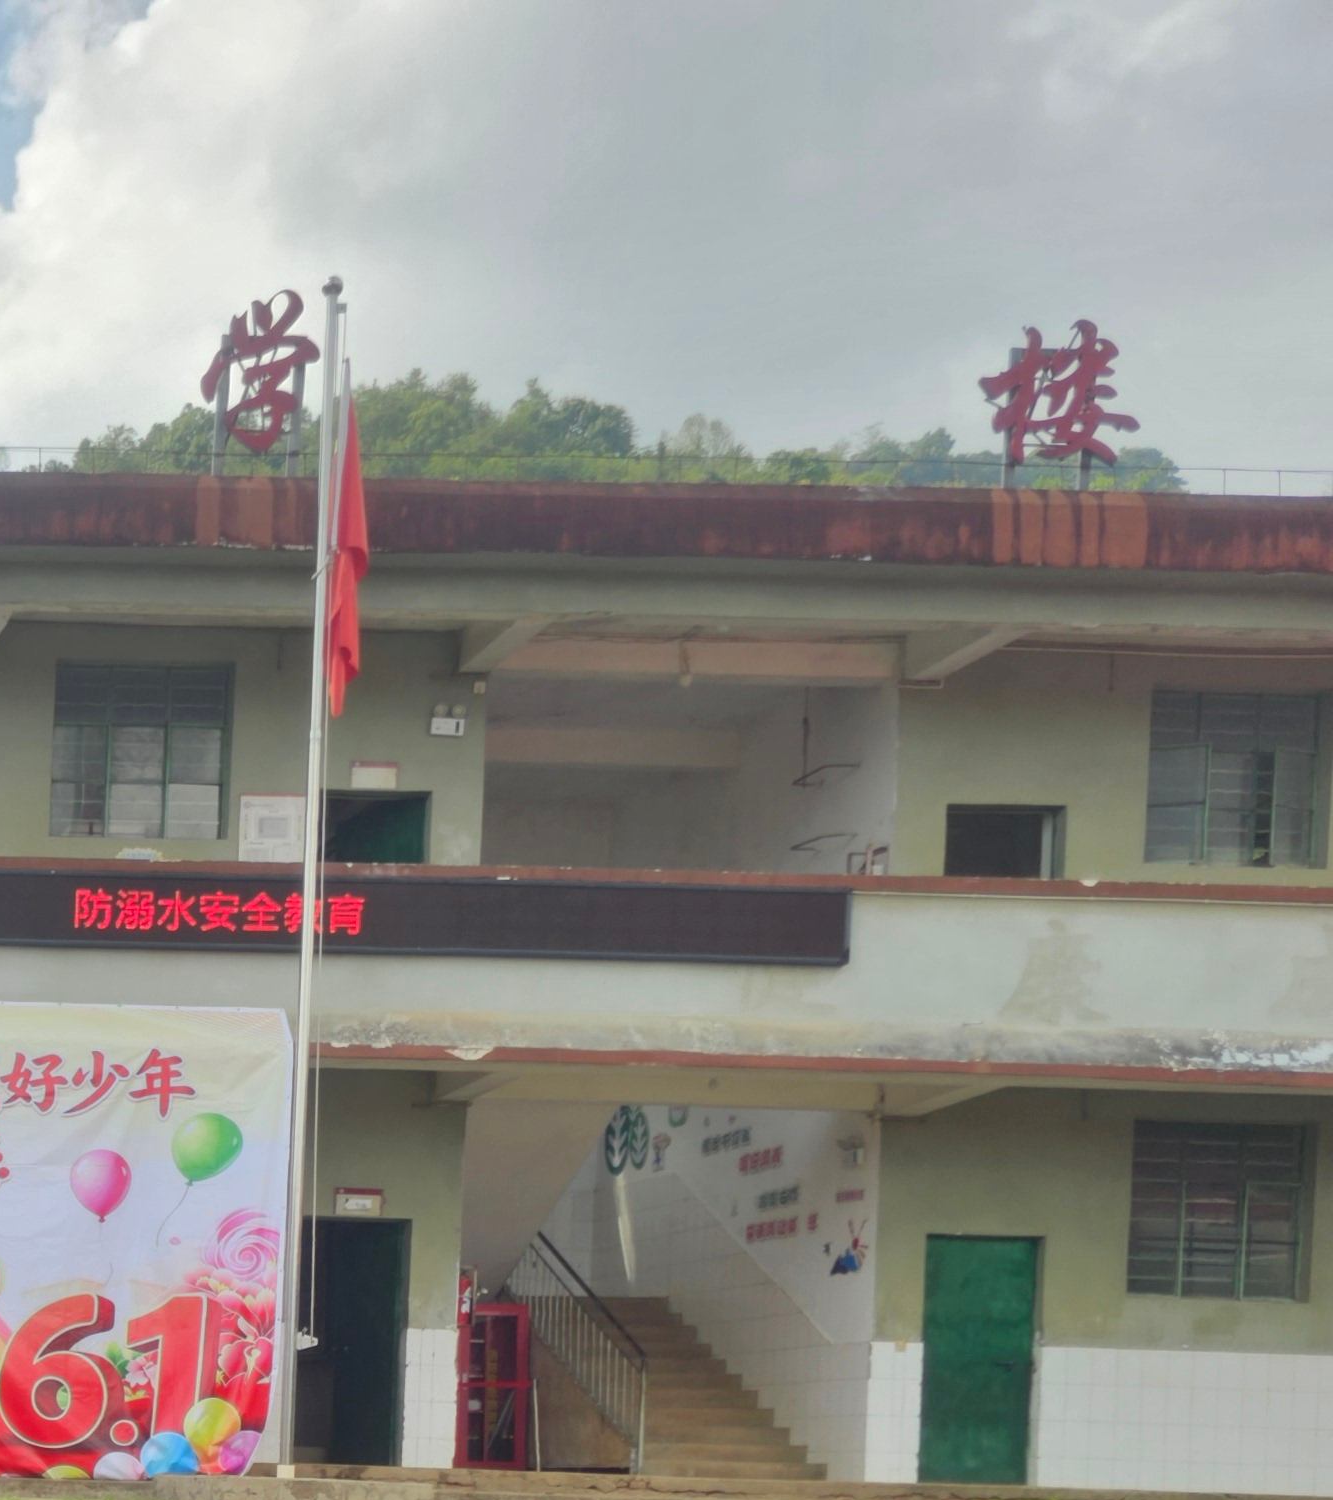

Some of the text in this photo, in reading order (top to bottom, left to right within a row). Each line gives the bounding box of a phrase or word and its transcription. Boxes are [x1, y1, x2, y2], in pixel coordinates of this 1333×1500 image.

[202, 289, 321, 453] 学
[980, 319, 1139, 466] 楼
[73, 886, 365, 936] 防溺水安全教育
